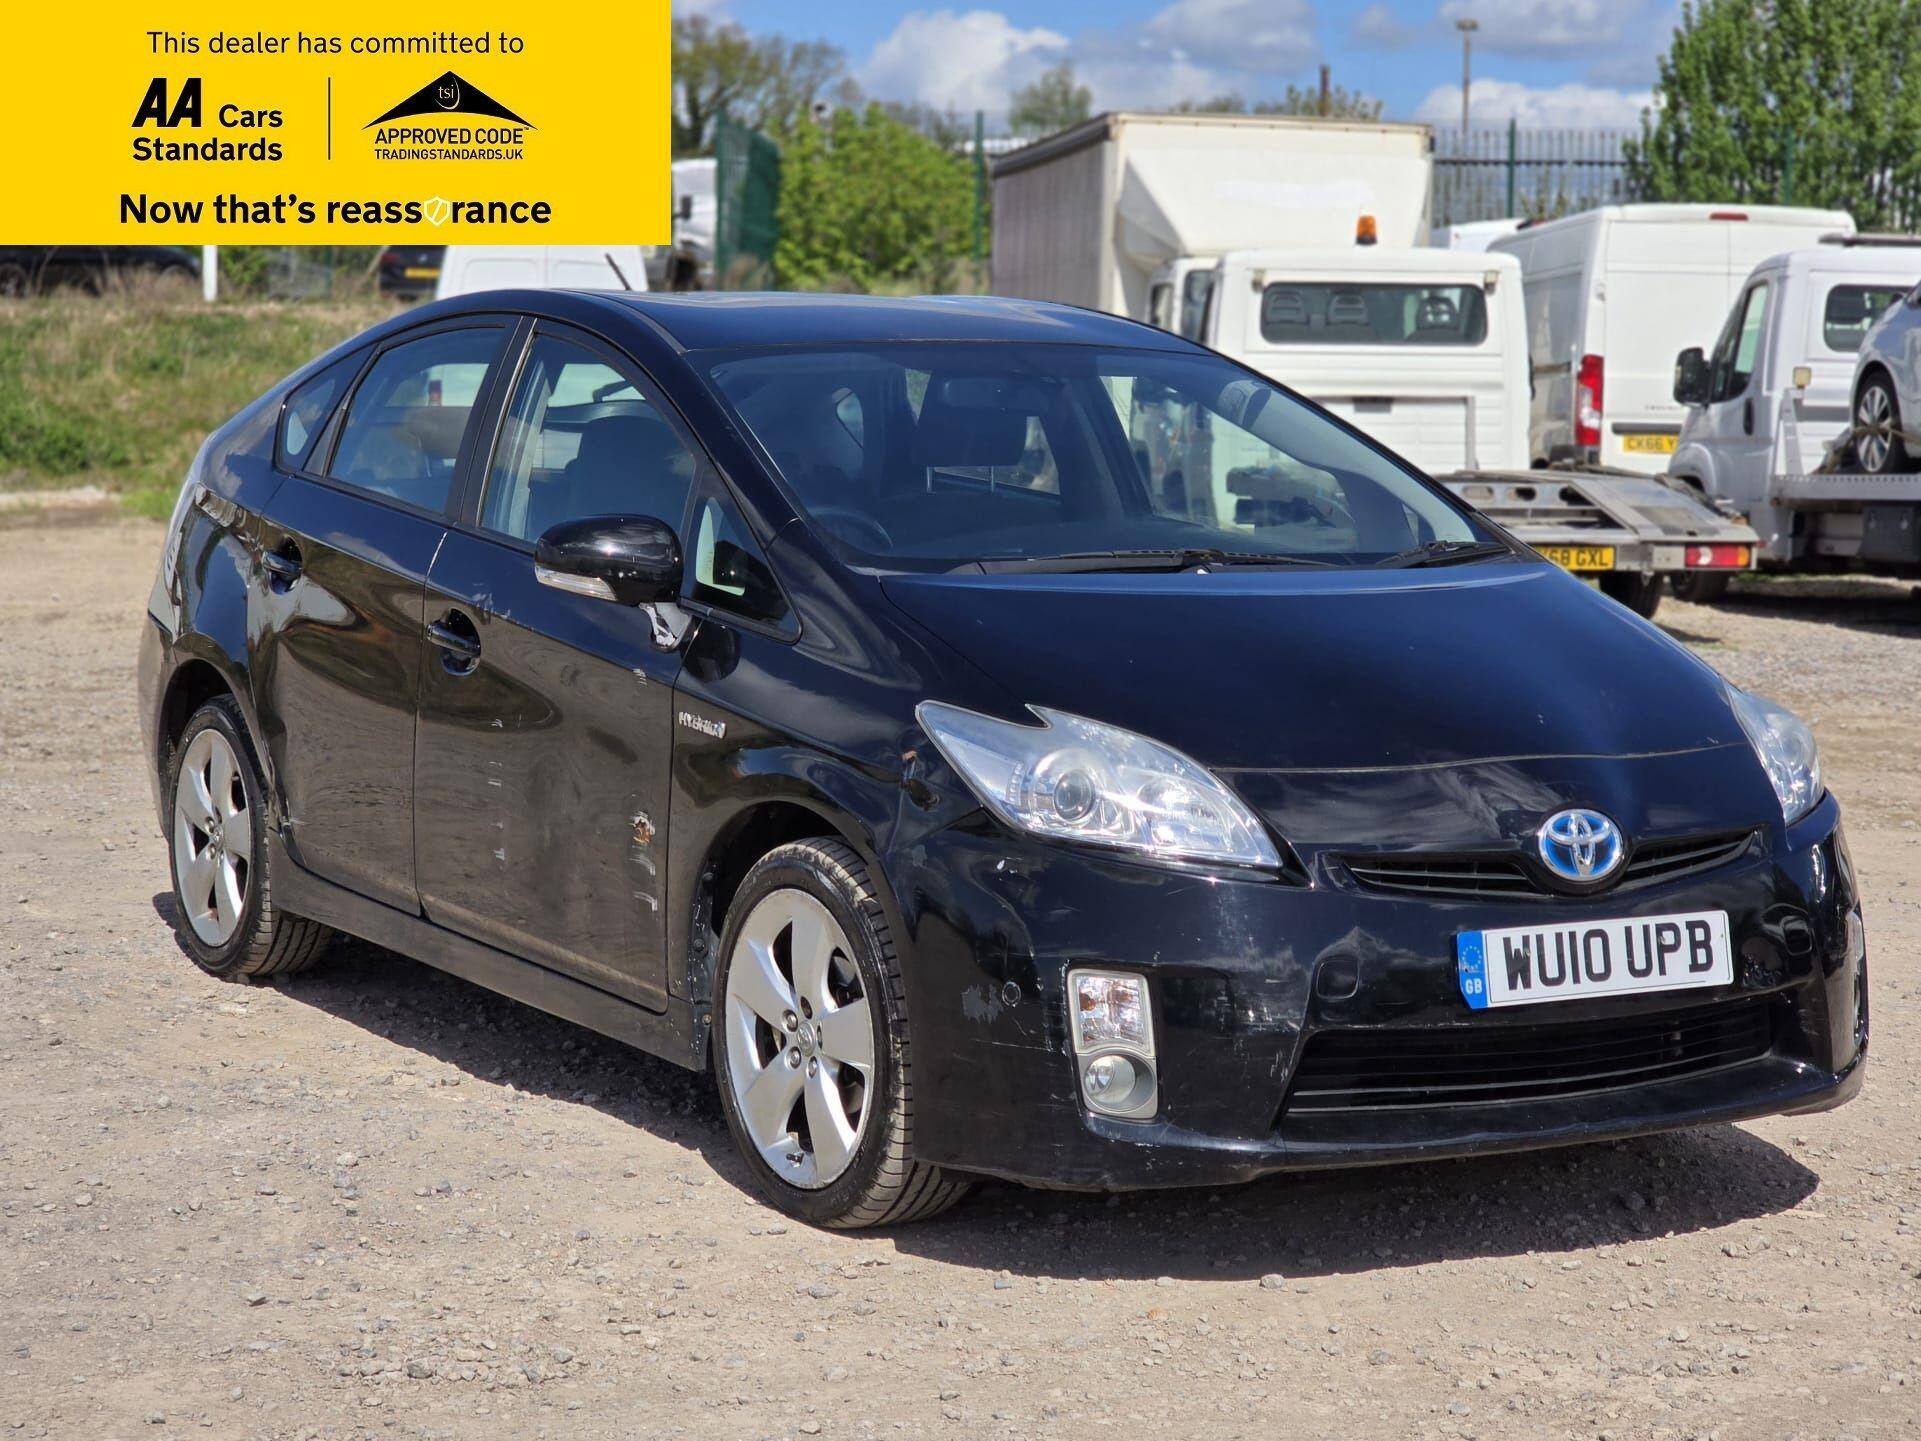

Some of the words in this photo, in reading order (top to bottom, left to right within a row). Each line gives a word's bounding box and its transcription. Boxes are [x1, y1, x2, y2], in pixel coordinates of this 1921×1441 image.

[1576, 548, 1609, 567] GXL
[1502, 928, 1612, 991] WU10
[1624, 919, 1715, 979] UPB
[1465, 977, 1483, 995] GB
